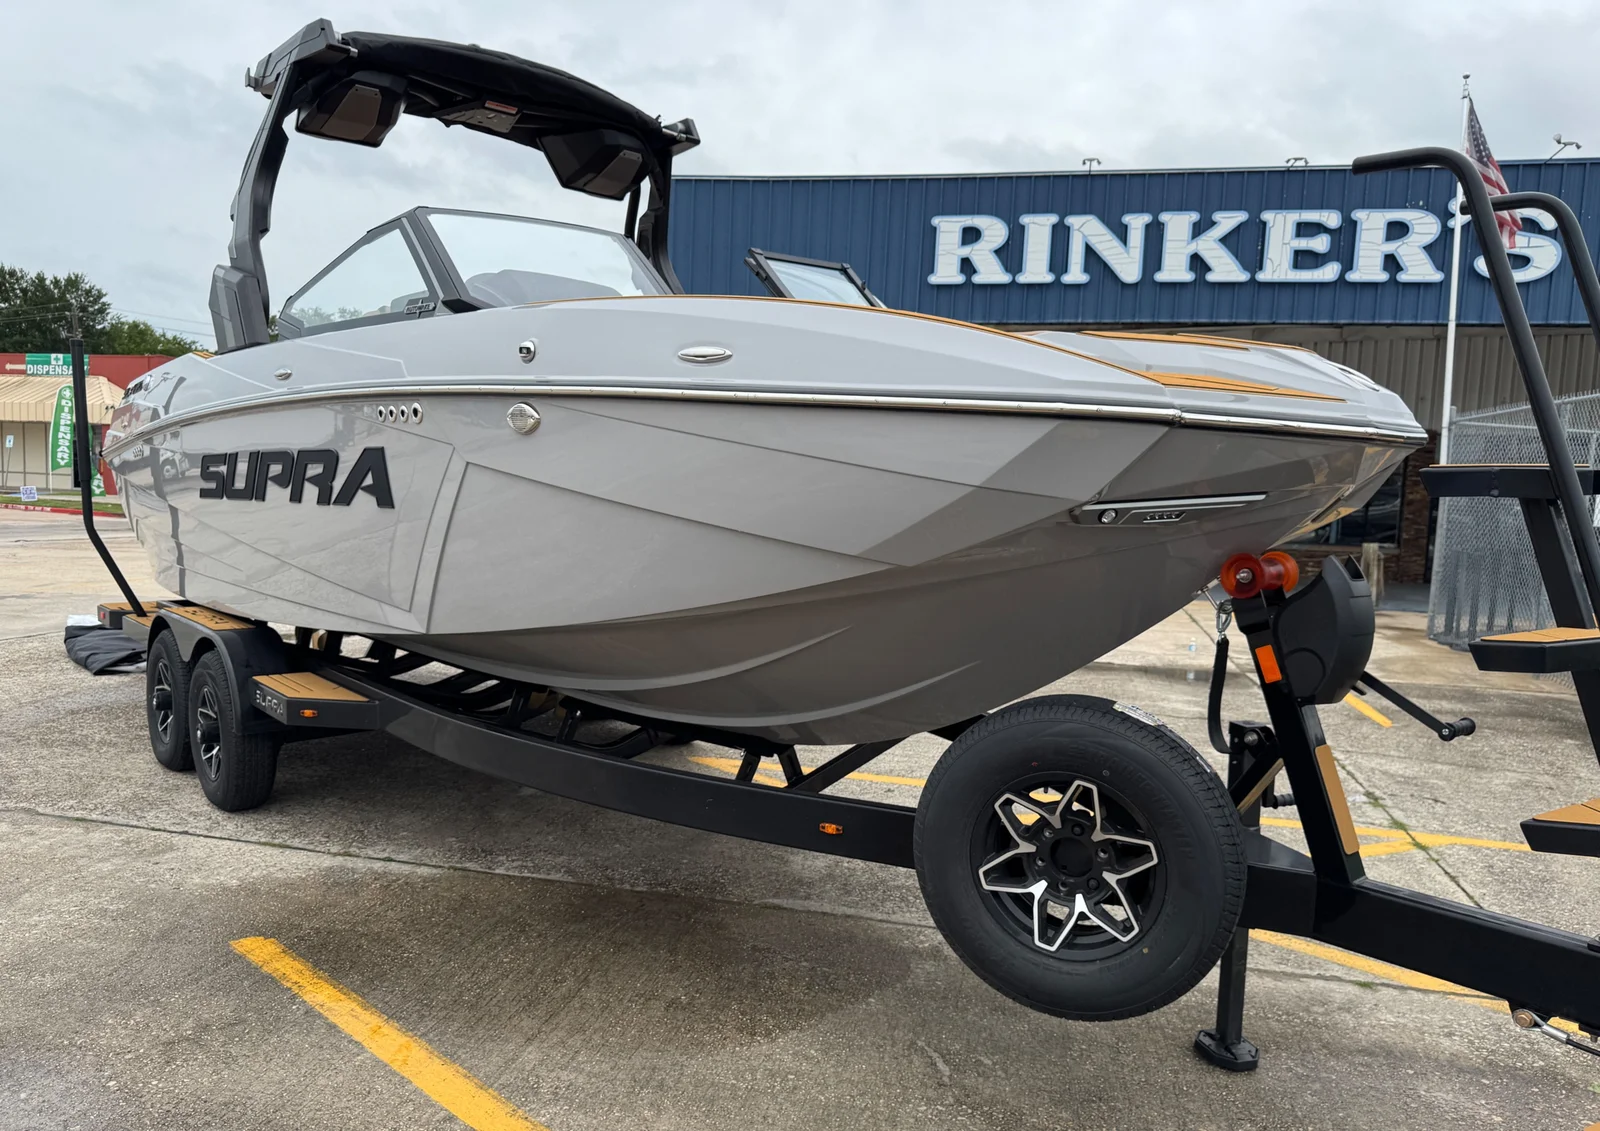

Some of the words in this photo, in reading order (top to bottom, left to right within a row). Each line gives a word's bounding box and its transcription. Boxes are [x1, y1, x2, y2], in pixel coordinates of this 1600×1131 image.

[928, 200, 1563, 284] RINKER'S
[27, 365, 87, 375] DISPENSA
[57, 399, 72, 465] DISPENSARY
[200, 447, 393, 508] SUPRA
